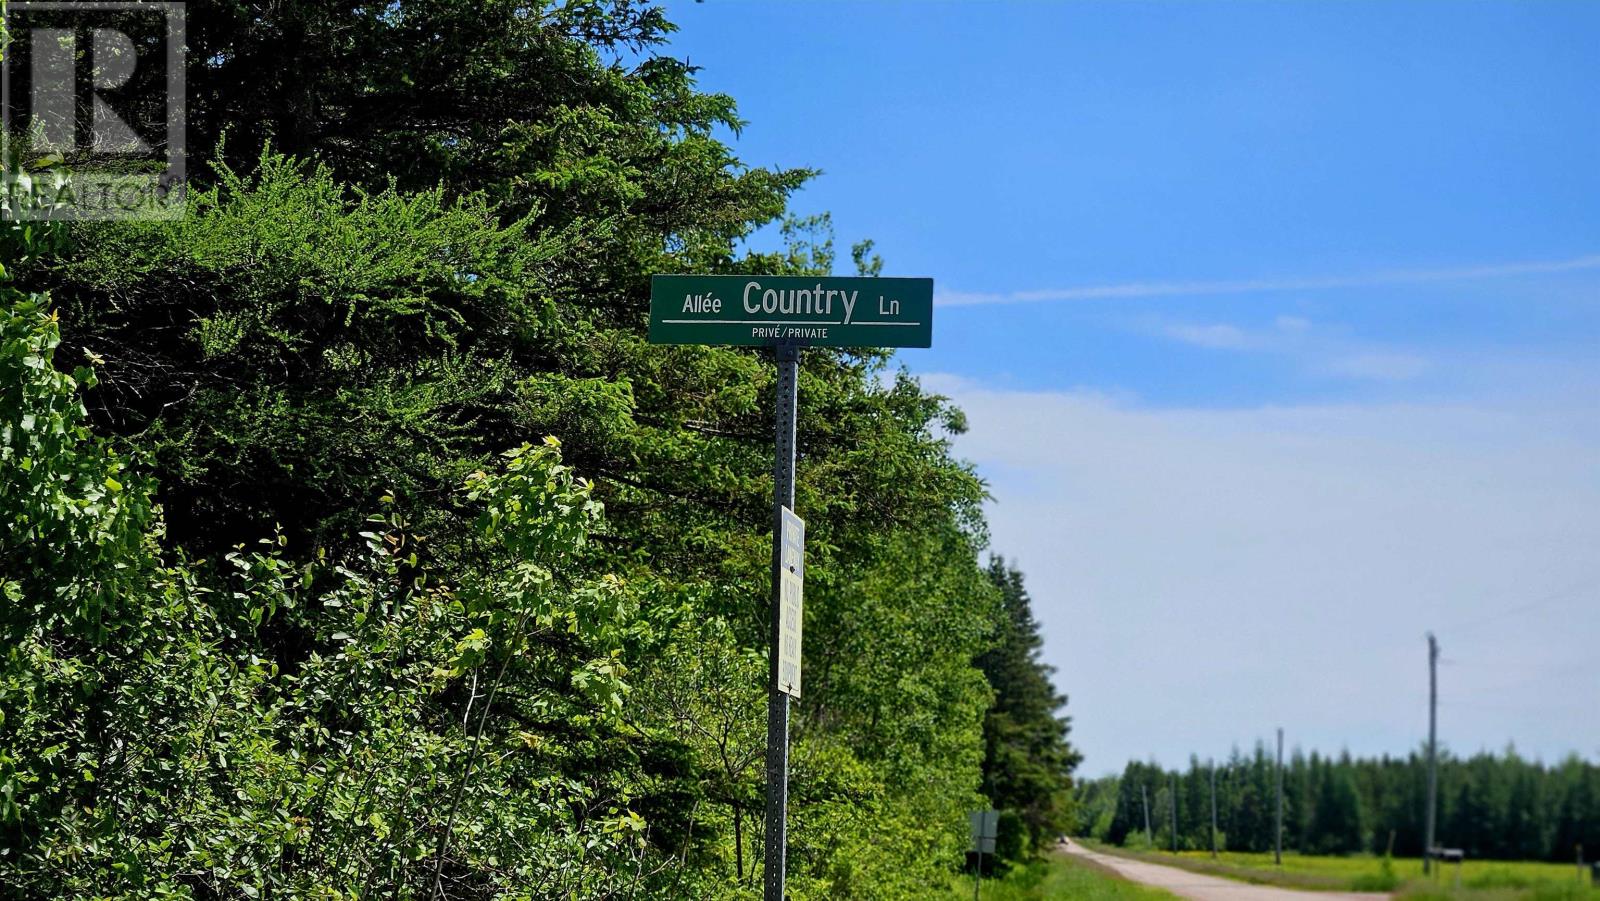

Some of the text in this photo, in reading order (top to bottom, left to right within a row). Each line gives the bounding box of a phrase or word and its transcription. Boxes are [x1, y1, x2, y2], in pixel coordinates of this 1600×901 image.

[682, 281, 900, 325] Allée Country Ln
